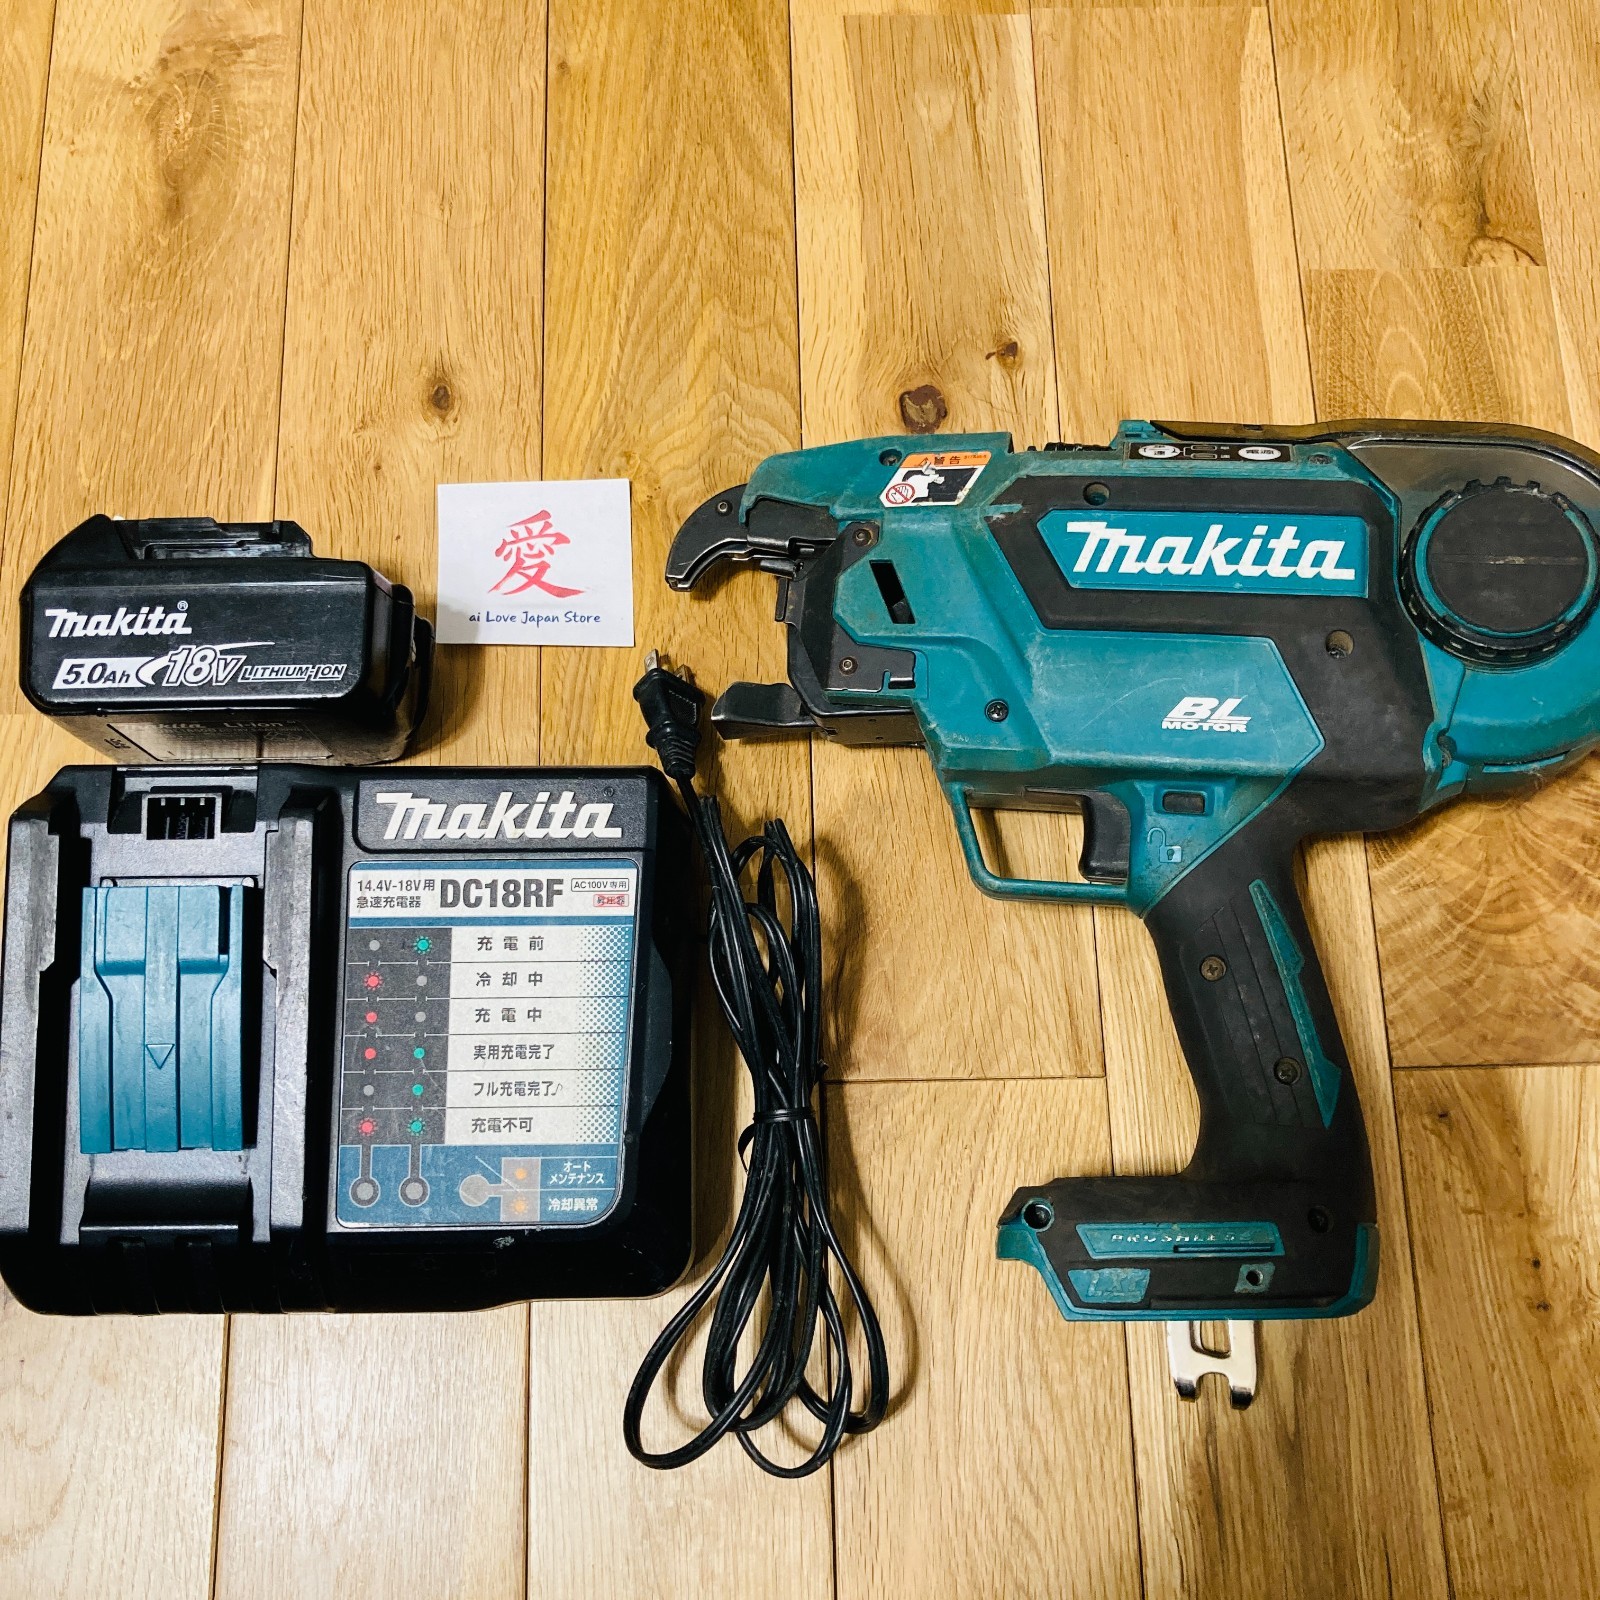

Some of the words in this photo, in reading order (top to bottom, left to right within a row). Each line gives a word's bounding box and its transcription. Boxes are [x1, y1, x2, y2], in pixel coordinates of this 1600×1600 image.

[488, 510, 586, 598] 愛
[469, 612, 481, 622] ai
[485, 611, 517, 623] Love
[521, 611, 560, 628] Japan
[564, 611, 601, 623] Store
[62, 662, 131, 686] 5.0Ah
[162, 645, 247, 687] 18V
[238, 664, 347, 683] LITHIUM-ION
[1164, 696, 1252, 722] BL
[1161, 720, 1247, 733] MOTOR
[440, 878, 564, 909] DC18RF
[356, 895, 422, 909] 急速充電器
[477, 936, 545, 952] 充電前
[475, 972, 543, 987] 冷却中
[474, 1007, 542, 1023] 充電中
[473, 1043, 555, 1060] 実用充電完了
[471, 1117, 534, 1133] 充電不可
[563, 1161, 591, 1171] オート
[549, 1172, 605, 1185] メンテナンス
[548, 1198, 599, 1212] 冷却異常
